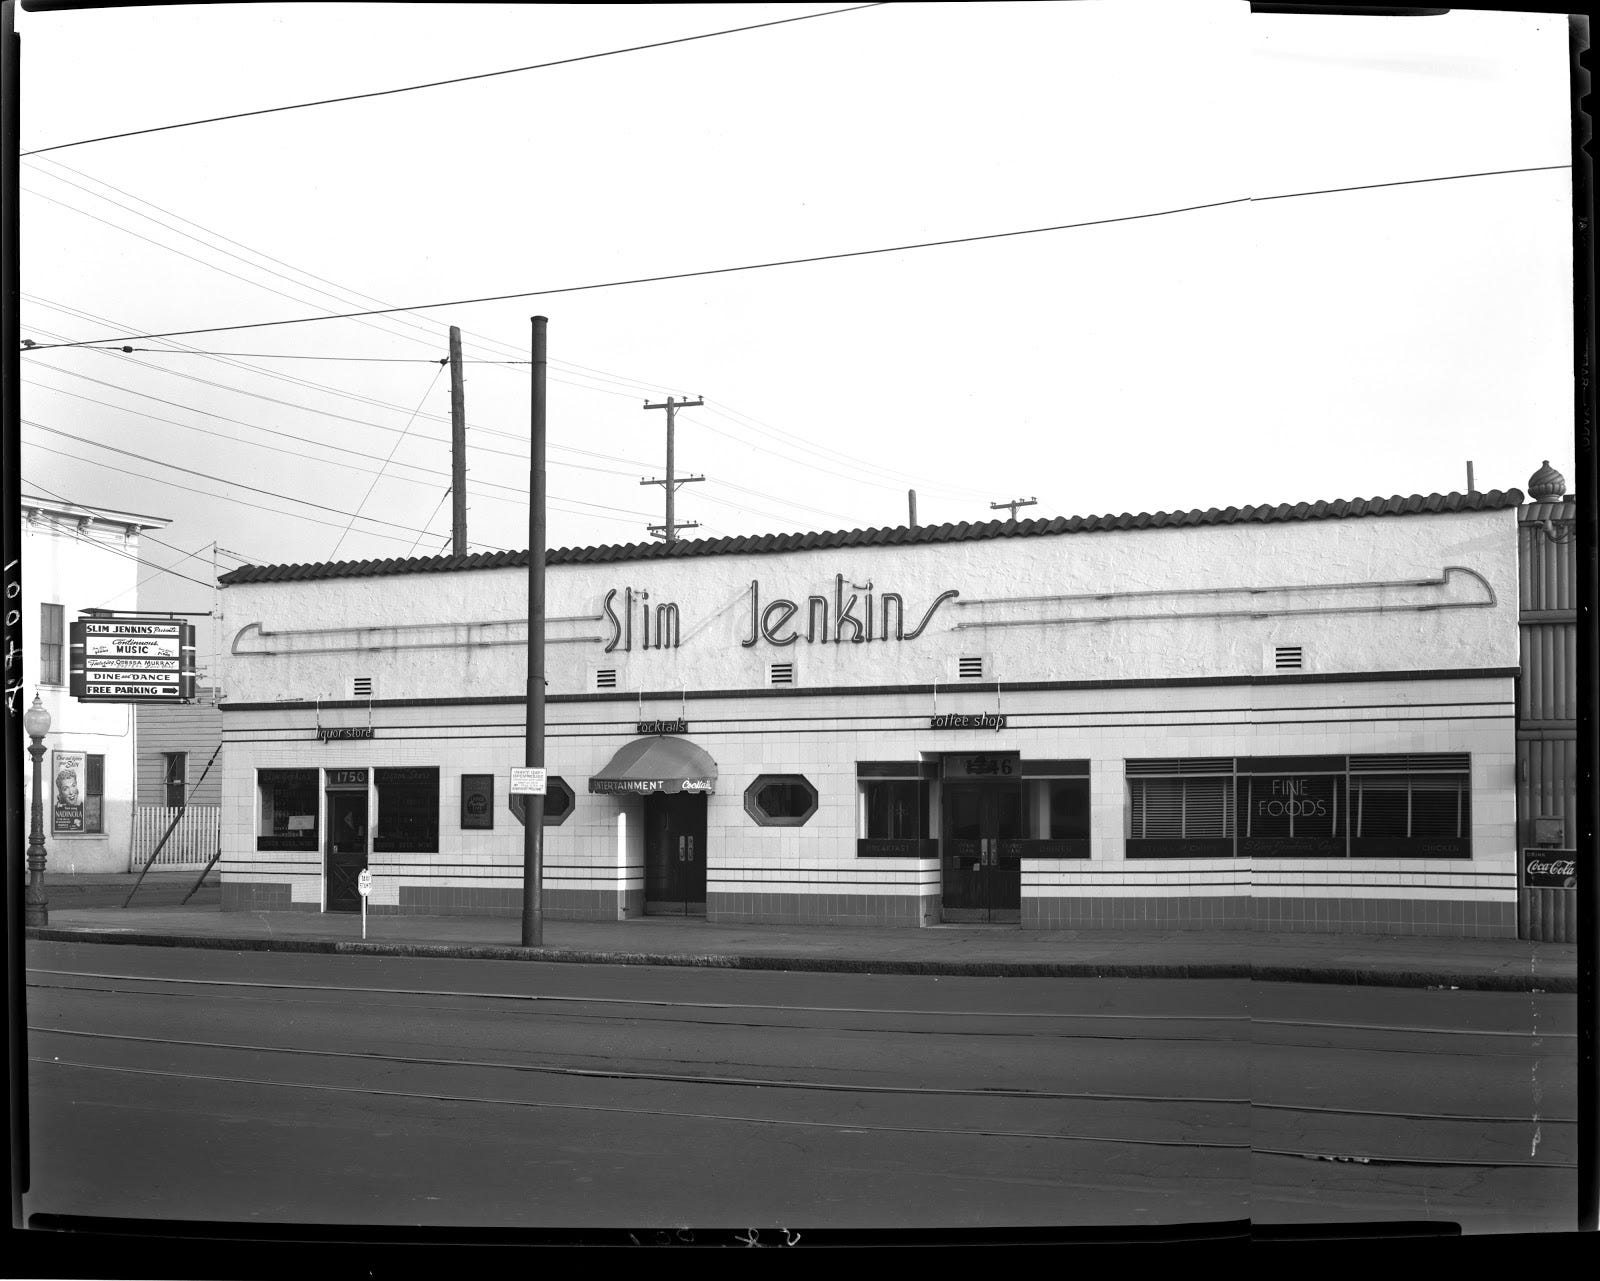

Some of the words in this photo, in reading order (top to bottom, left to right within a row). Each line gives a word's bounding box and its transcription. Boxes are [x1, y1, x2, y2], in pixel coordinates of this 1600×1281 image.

[604, 586, 681, 653] Slim
[742, 573, 959, 647] Jenkins
[87, 625, 109, 633] SLIM
[87, 686, 111, 694] FREE
[930, 713, 969, 727] coffee
[974, 711, 1004, 732] shop
[346, 727, 371, 738] store
[338, 771, 365, 783] 1750
[1272, 780, 1309, 795] FINE
[1259, 800, 1327, 816] FOODS
